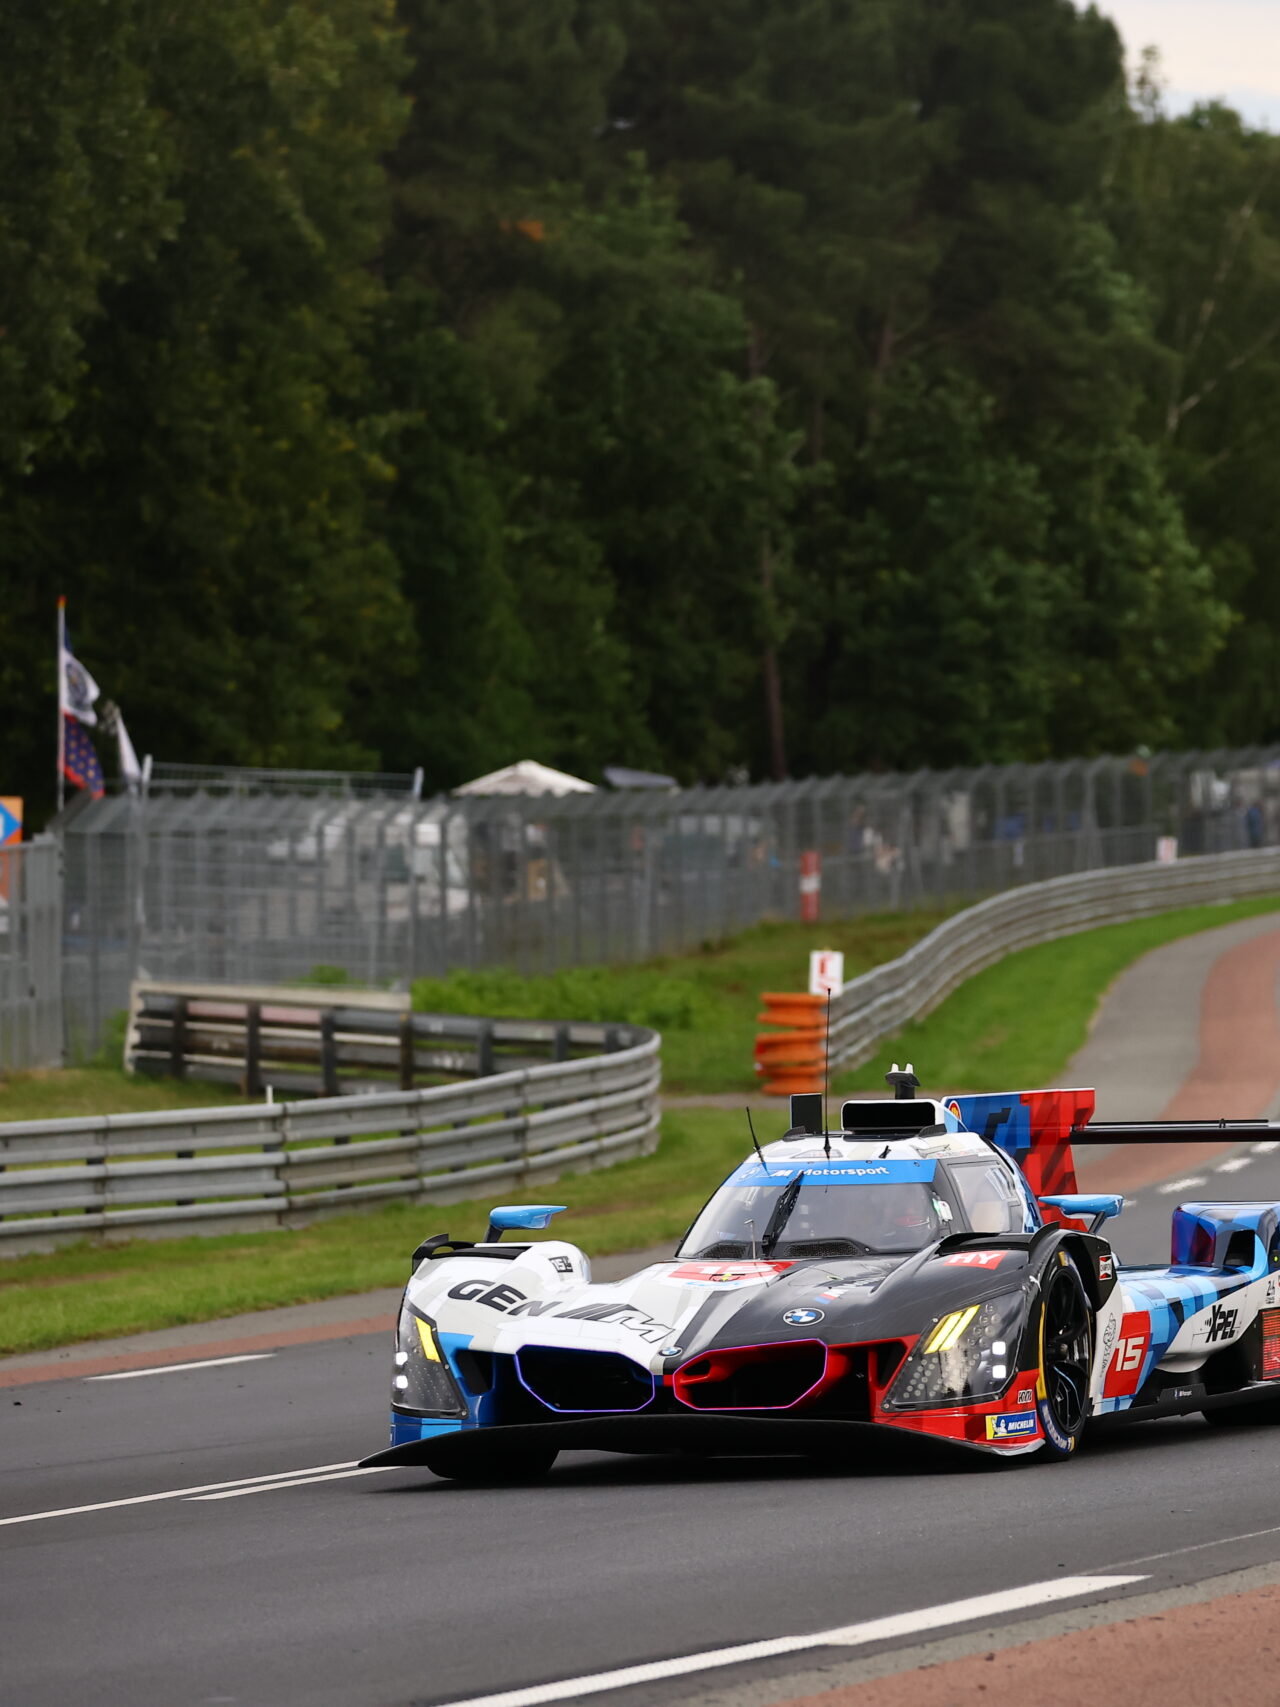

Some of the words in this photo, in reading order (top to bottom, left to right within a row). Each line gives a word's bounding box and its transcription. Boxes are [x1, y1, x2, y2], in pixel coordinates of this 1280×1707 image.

[799, 1166, 890, 1177] Motorsport
[950, 1252, 1001, 1265] HY
[447, 1279, 563, 1317] GEN
[1205, 1304, 1239, 1343] XPEL
[1115, 1336, 1146, 1372] 15
[1007, 1418, 1035, 1431] MICHELIN
